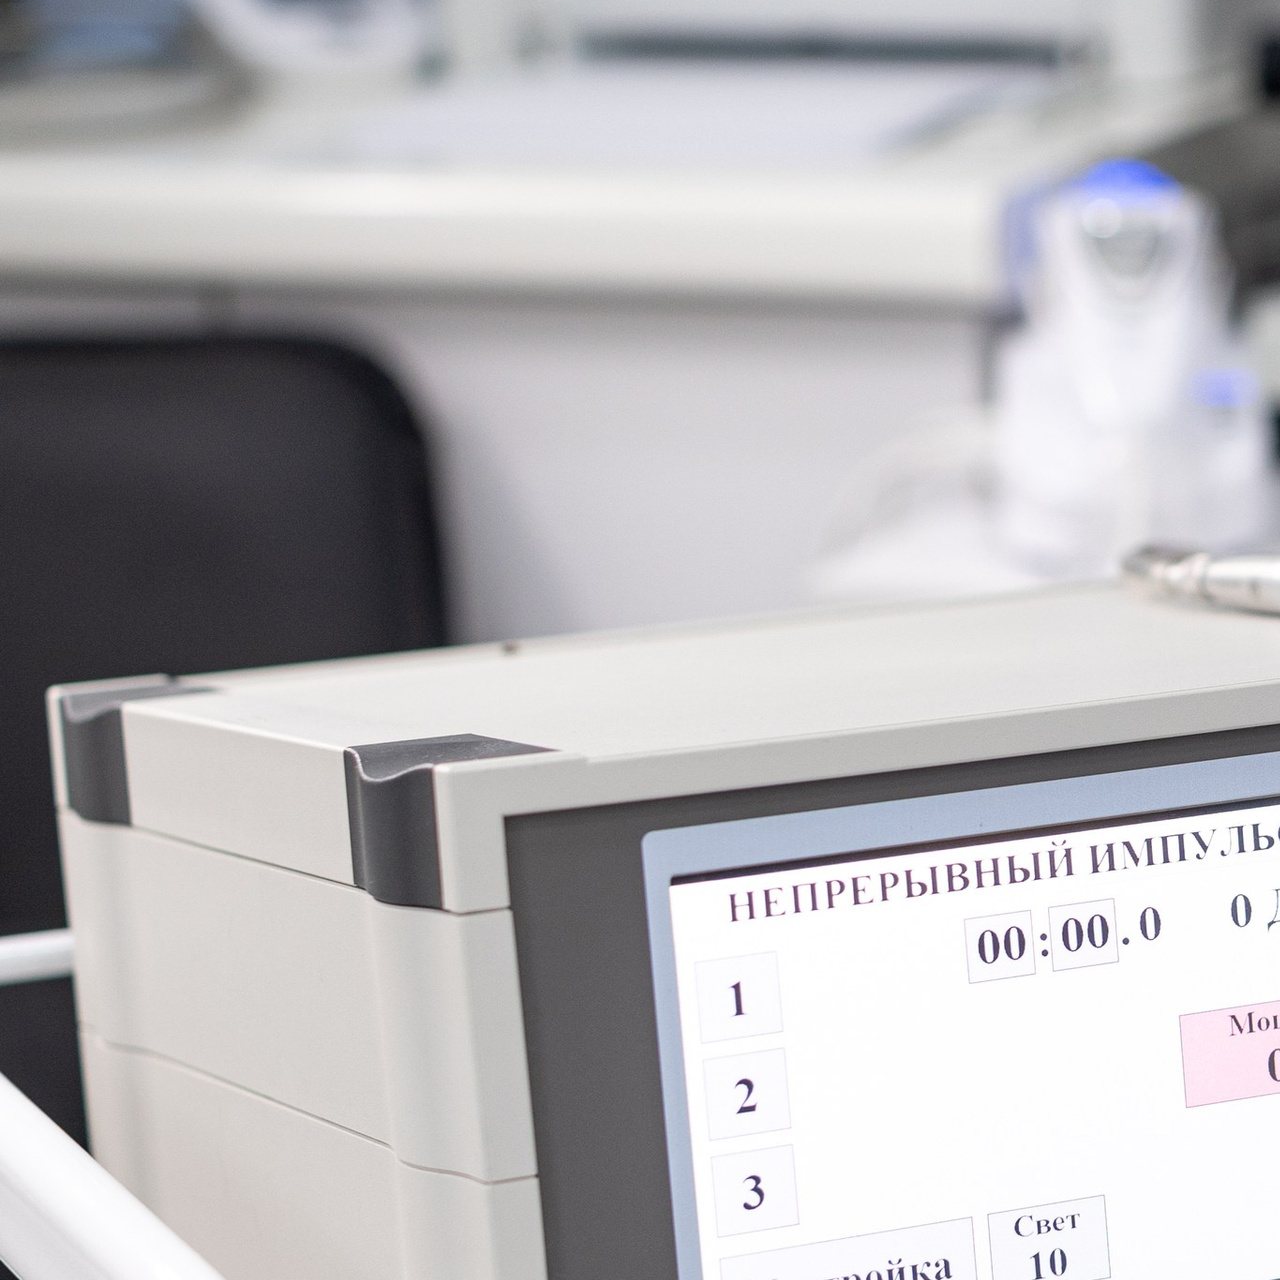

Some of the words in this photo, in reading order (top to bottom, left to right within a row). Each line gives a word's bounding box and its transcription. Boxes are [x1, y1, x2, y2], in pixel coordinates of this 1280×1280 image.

[729, 840, 1074, 921] НЕПРЕРЫВНЫЙ
[1231, 894, 1252, 927] 0
[728, 981, 748, 1017] 1
[735, 1078, 757, 1114] 2
[743, 1175, 765, 1210] 3
[1014, 1212, 1081, 1238] Свет
[1029, 1248, 1068, 1280] 10
